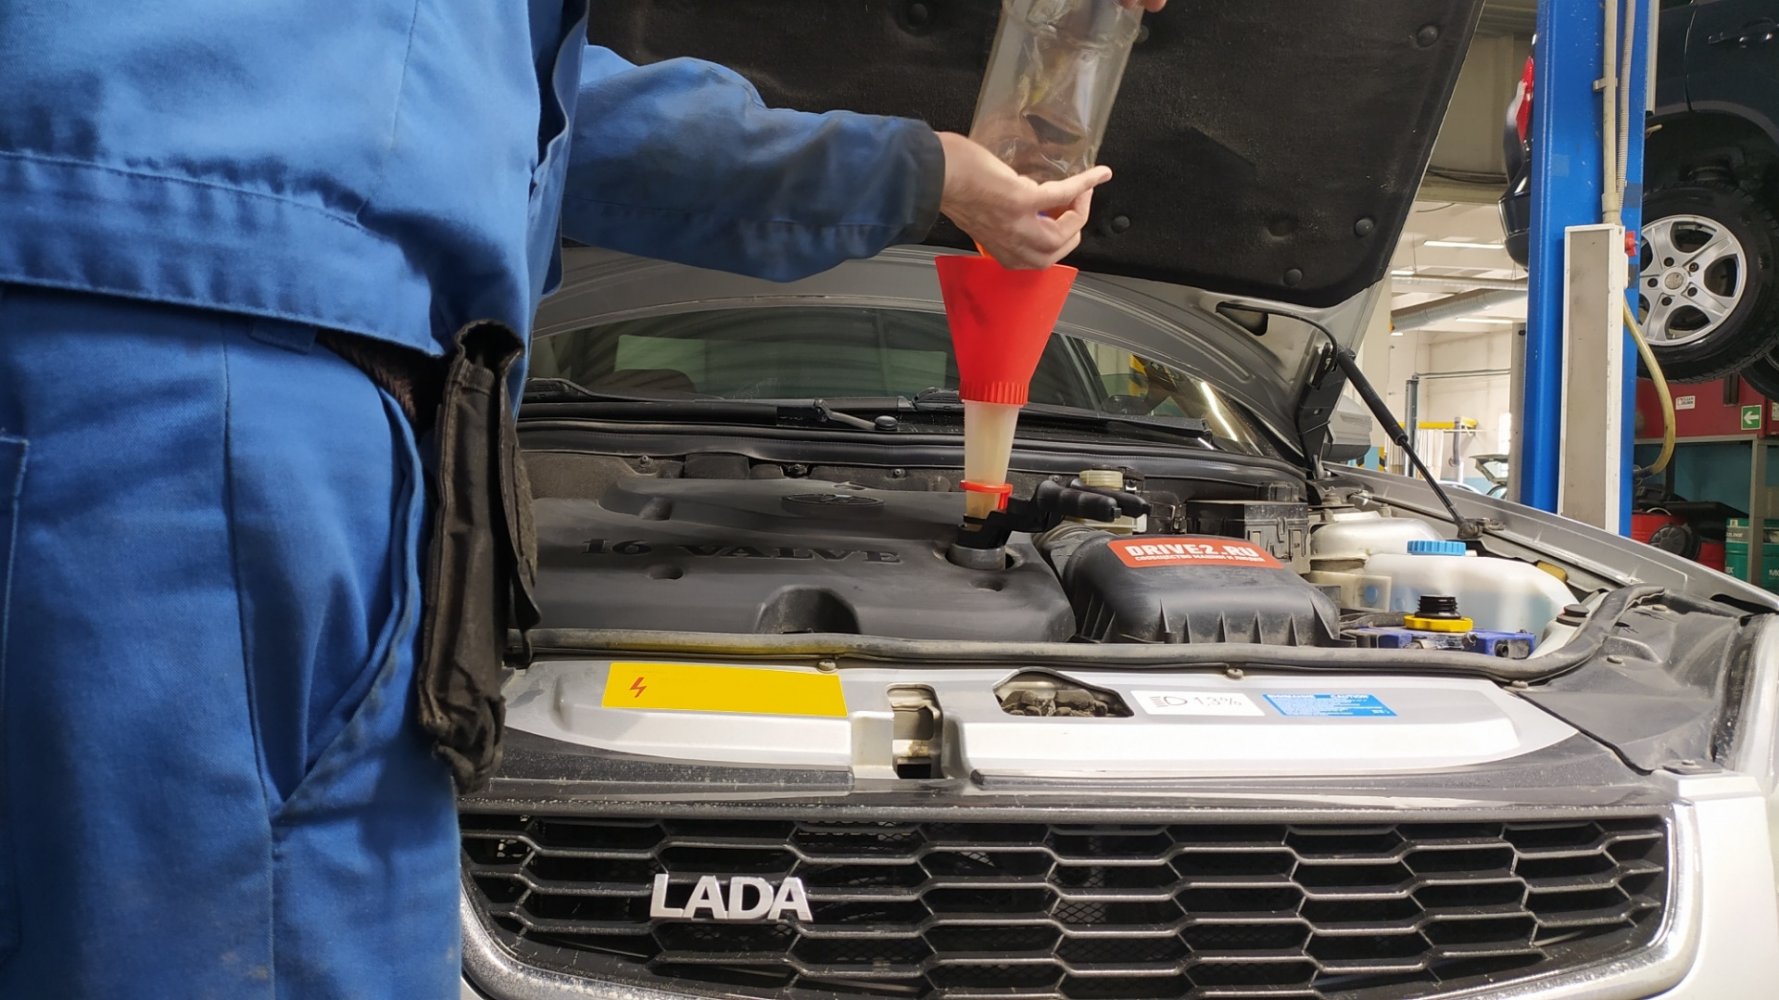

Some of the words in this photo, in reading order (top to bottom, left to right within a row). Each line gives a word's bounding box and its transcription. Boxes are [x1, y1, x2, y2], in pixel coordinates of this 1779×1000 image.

[582, 538, 652, 555] 16
[678, 544, 903, 564] VALVE
[1125, 544, 1259, 557] DRIVE2.RU
[650, 873, 813, 922] LADA
